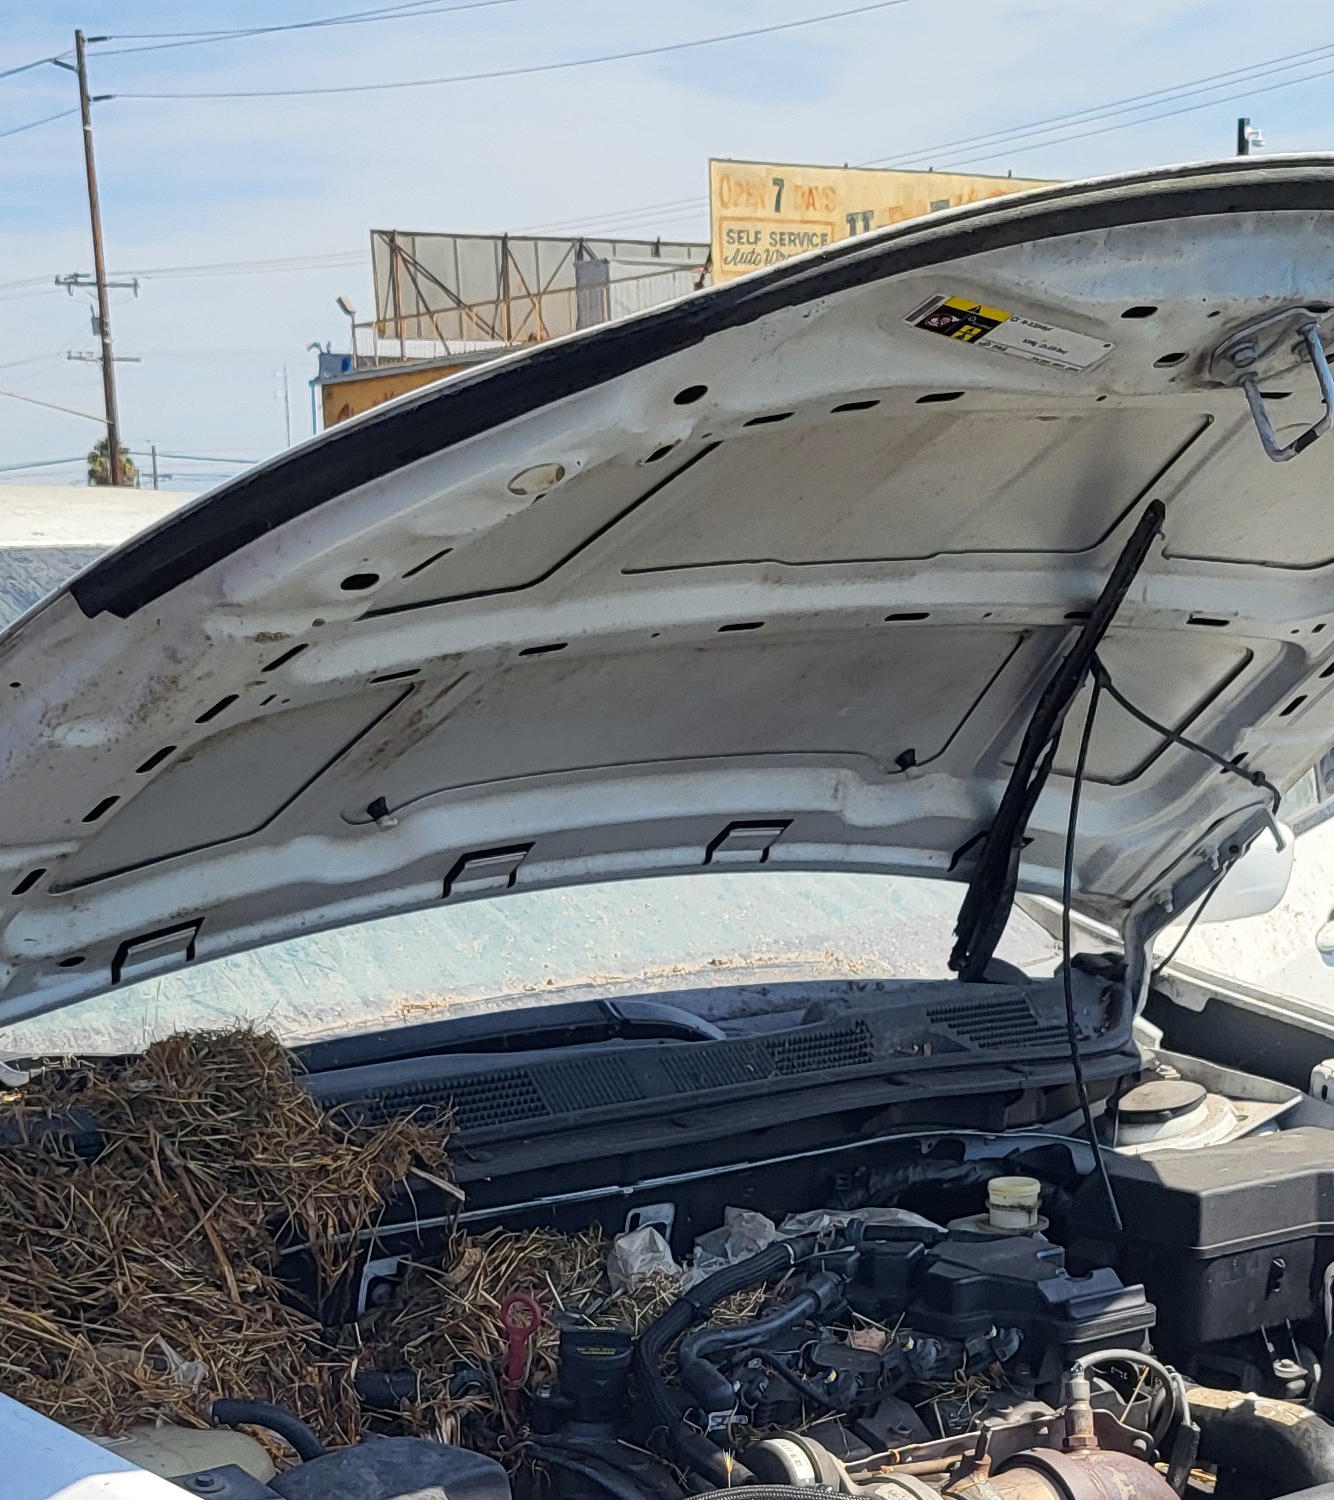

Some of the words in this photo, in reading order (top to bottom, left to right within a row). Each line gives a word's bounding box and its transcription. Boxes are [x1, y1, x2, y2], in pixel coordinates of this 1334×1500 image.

[772, 178, 785, 213] 7
[793, 185, 836, 213] DAYS
[725, 229, 762, 245] SELF
[769, 230, 828, 247] SERVICE
